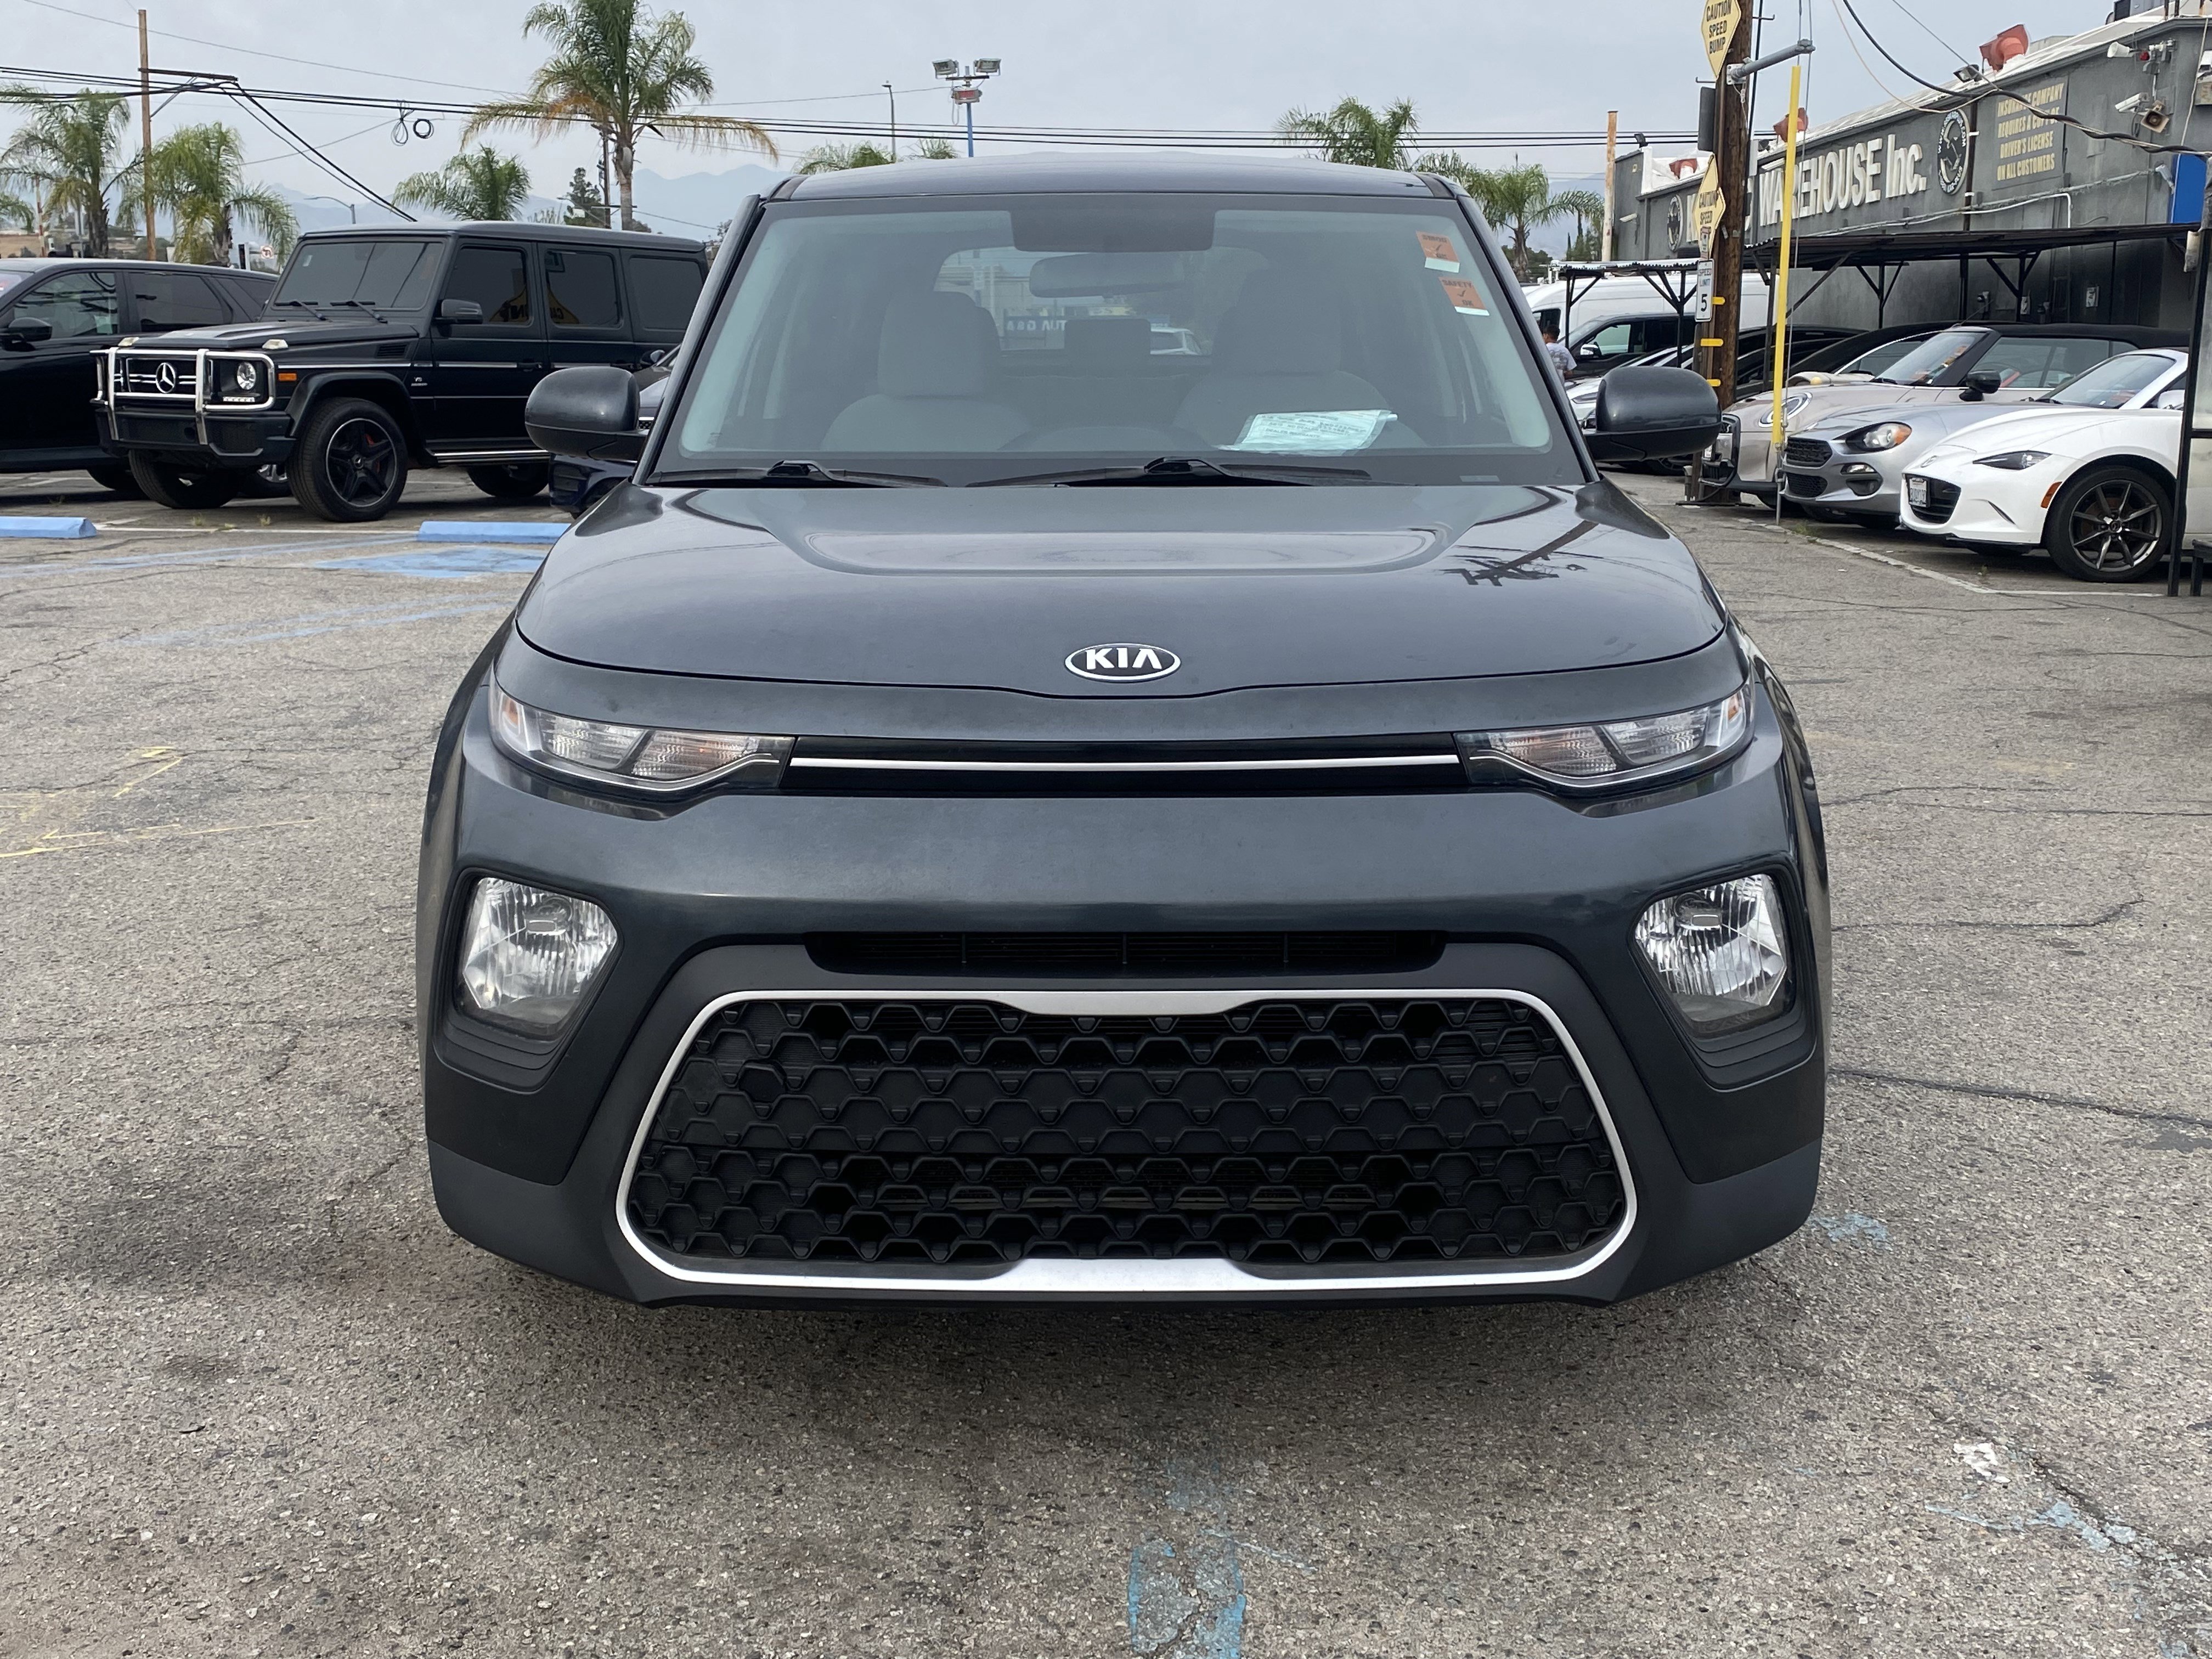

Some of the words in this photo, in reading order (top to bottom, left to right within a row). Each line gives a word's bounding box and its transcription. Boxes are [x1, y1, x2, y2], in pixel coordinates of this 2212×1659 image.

[1707, 0, 1732, 21] CAUTION
[1709, 20, 1727, 38] SPEED
[1709, 37, 1725, 54] BUMP
[2032, 83, 2064, 107] COMPANY
[1998, 116, 2026, 138] REQUIRES
[2027, 115, 2032, 131] A
[2000, 138, 2026, 159] DRIVER'S
[2028, 131, 2053, 153] LICENSE
[1885, 133, 1927, 199] Inc.
[1997, 165, 2006, 180] ON
[2006, 162, 2016, 179] ALL
[2017, 153, 2055, 177] CUSTOMERS
[1700, 210, 1713, 225] SPEED
[1441, 279, 1472, 288] SAFETY
[1700, 294, 1708, 312] 5
[1085, 647, 1163, 670] KIA
